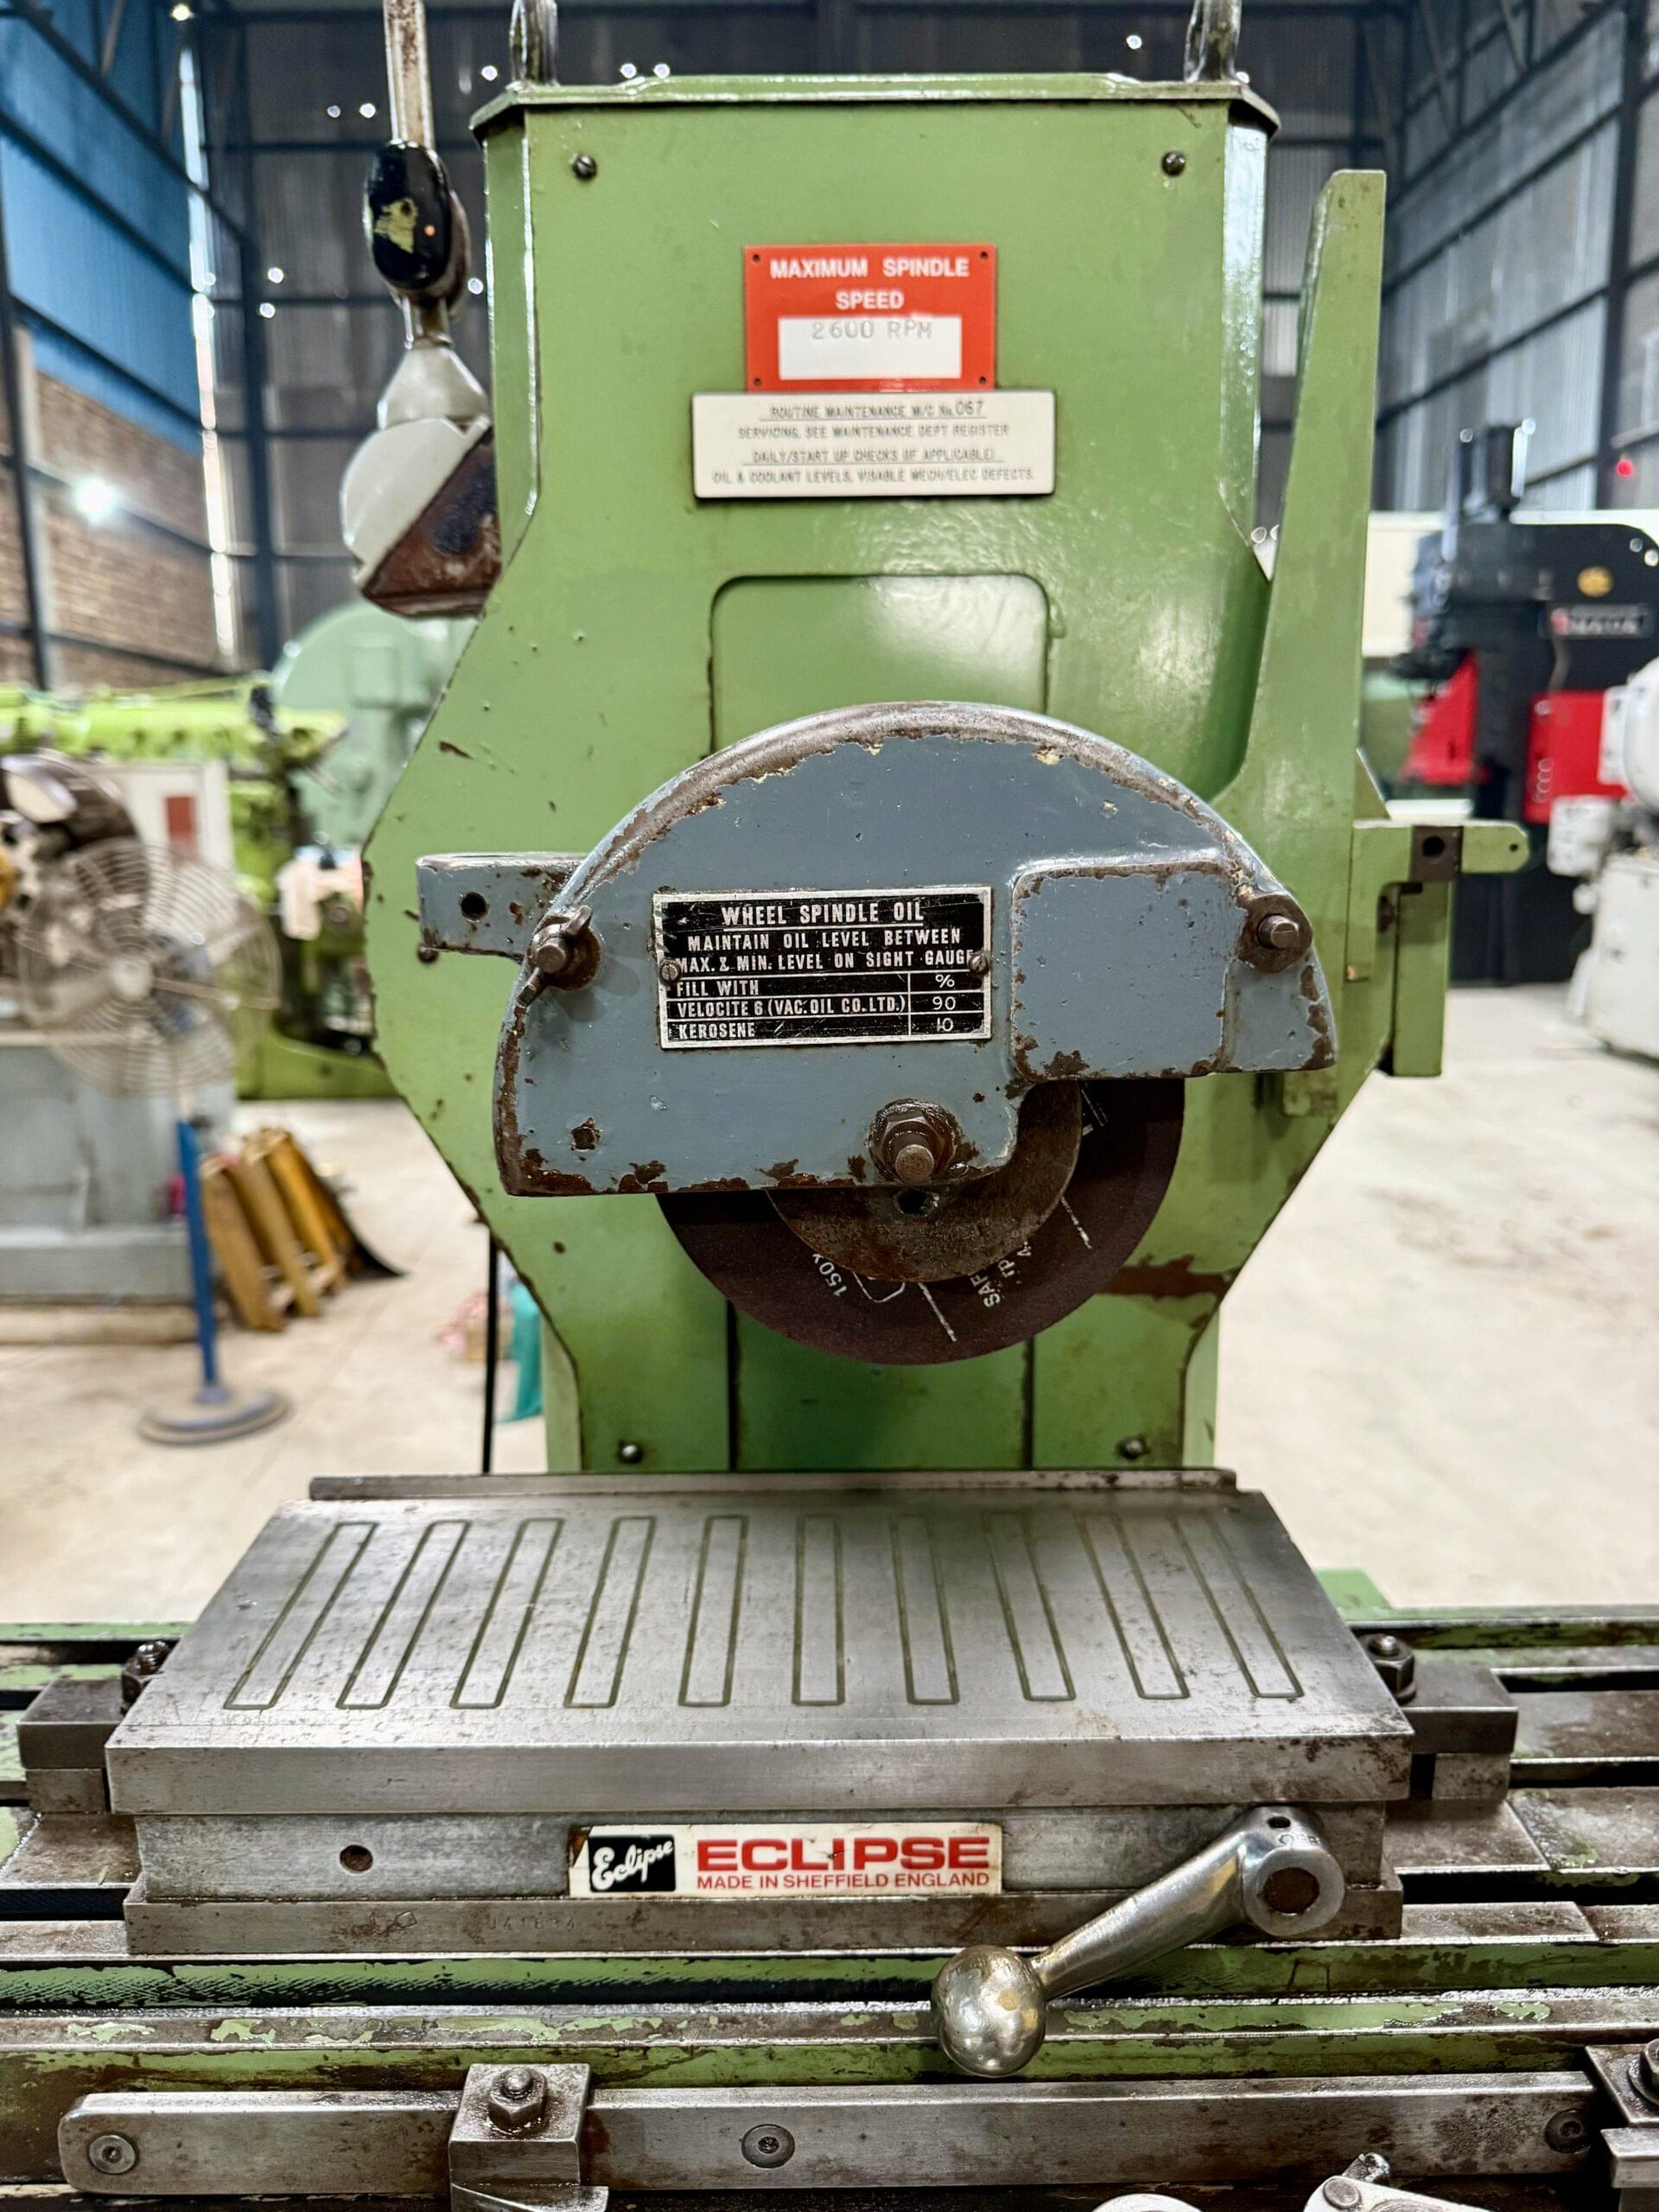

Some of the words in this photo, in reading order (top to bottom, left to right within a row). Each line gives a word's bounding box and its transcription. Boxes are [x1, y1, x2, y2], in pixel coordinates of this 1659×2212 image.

[770, 257, 868, 278] MAXIMUM
[882, 257, 969, 277] SPINDLE
[835, 289, 905, 309] SPEED
[810, 320, 874, 340] 2600
[887, 319, 933, 340] RPM
[771, 405, 819, 419] ROUTINE
[825, 404, 906, 418] MAINTENANCE
[955, 400, 984, 416] 067
[805, 427, 828, 439] SEE
[832, 424, 913, 438] MAINTENANCE
[953, 424, 1009, 436] REGISTER
[833, 449, 849, 462] UP
[854, 448, 898, 462] CHECKS
[713, 471, 732, 484] OIL
[750, 470, 802, 484] COOLANT
[721, 905, 787, 926] WHEEL
[800, 903, 879, 924] SPINDLE
[893, 901, 925, 922] OIL
[688, 933, 769, 951] MAINTAIN
[784, 932, 809, 949] OIL
[822, 931, 869, 948] LEVEL
[884, 928, 961, 946] BETWEEN
[675, 957, 715, 973] MAX.
[719, 956, 730, 972] &
[779, 953, 823, 970] LEVEL
[834, 952, 855, 969] ON
[866, 950, 914, 967] SIGHT
[677, 981, 709, 997] FILL
[716, 980, 760, 996] WITH
[935, 974, 956, 988] %
[677, 1001, 753, 1018] VELOCITE
[754, 1001, 764, 1016] 6
[932, 996, 957, 1010] 90
[679, 1022, 755, 1039] KEROSENE
[937, 1017, 954, 1032] 10
[997, 1259, 1015, 1278] rp
[969, 1274, 1001, 1307] SAF
[696, 1836, 990, 1872] ECLIPSE
[591, 1840, 674, 1891] Eclipse
[696, 1875, 753, 1890] MADE
[760, 1875, 779, 1889] IN
[783, 1872, 889, 1889] SHEFFIELD
[894, 1872, 989, 1888] ENGLAND
